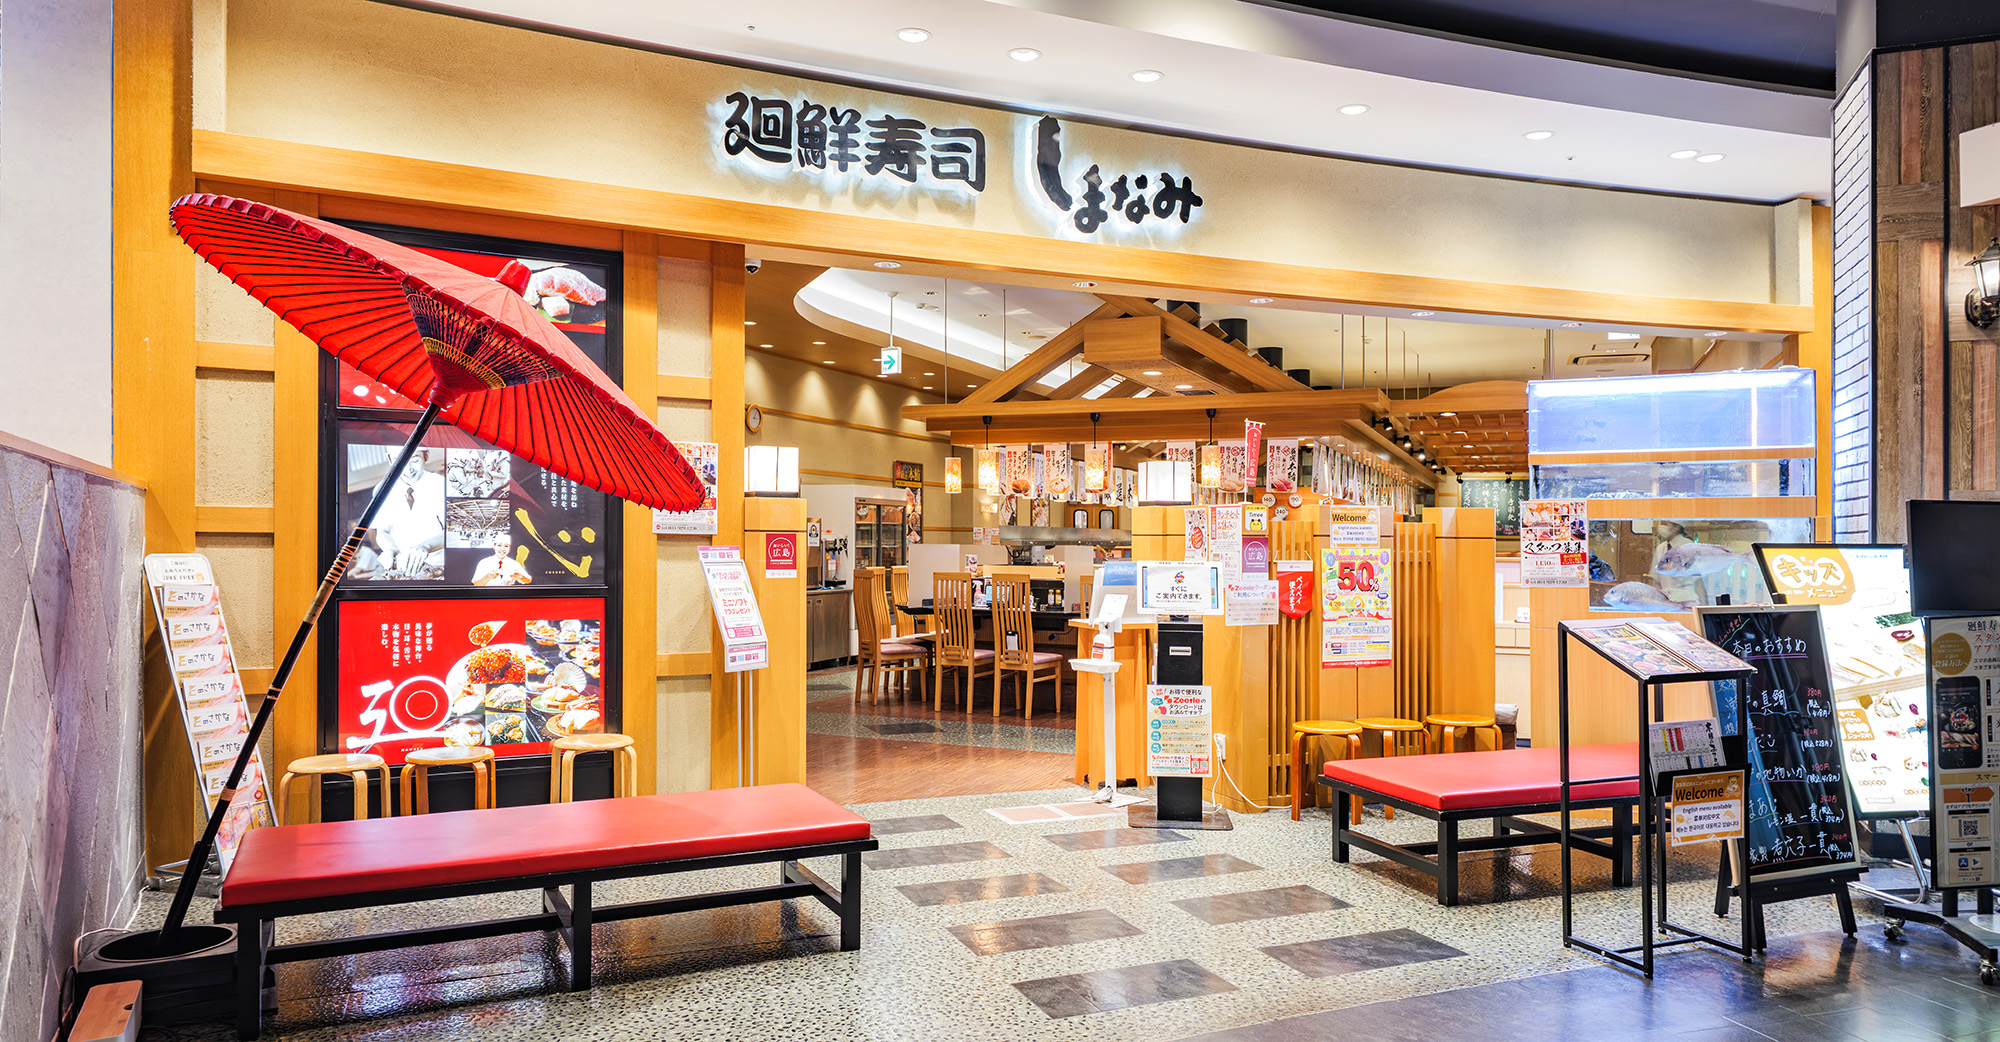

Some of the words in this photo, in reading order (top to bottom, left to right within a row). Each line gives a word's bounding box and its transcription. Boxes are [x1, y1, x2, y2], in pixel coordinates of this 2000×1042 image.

[724, 91, 987, 193] 廻鮮寿司
[1037, 114, 1203, 234] しまなみ
[1332, 513, 1367, 523] Welcome
[773, 548, 790, 557] 広島
[1248, 551, 1263, 561] 広島
[1337, 560, 1380, 592] 50%
[1776, 557, 1841, 583] キッズ
[1170, 585, 1188, 593] すぐに
[1295, 575, 1303, 605] ペイペイ
[1806, 587, 1846, 599] メニュー
[722, 598, 748, 607] ミニソフト
[1155, 592, 1202, 600] ご案内できます。
[1288, 580, 1296, 614] 使えます。
[1967, 619, 1998, 632] 廻鮮寿
[381, 623, 389, 649] 楽しむ。
[1732, 636, 1807, 656] 本日のおすすめ
[1747, 689, 1789, 715] の真鯛
[1750, 763, 1808, 782] の地物いか
[1811, 762, 1830, 772] 380円
[1675, 787, 1724, 802] Welcome
[1965, 793, 1971, 803] 1
[1682, 807, 1698, 815] English
[1712, 803, 1732, 811] available
